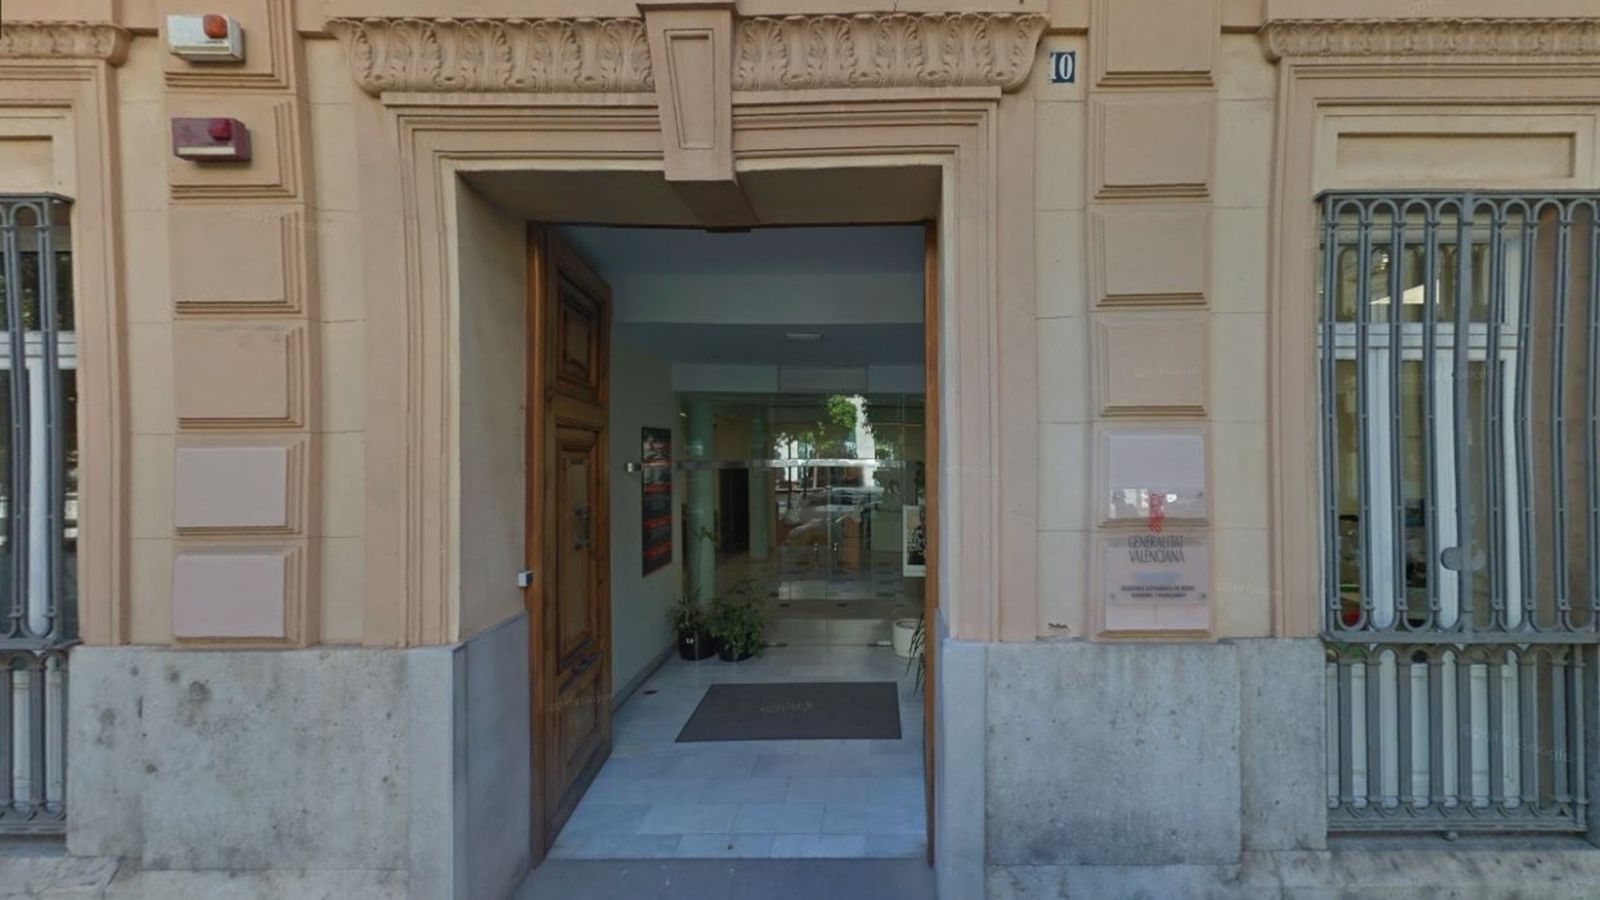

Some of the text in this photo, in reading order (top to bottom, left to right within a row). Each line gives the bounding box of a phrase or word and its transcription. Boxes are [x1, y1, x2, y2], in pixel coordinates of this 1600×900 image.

[1051, 53, 1073, 80] 10
[1128, 535, 1184, 549] GENERALITAT
[1128, 549, 1185, 563] VALENCIANA
